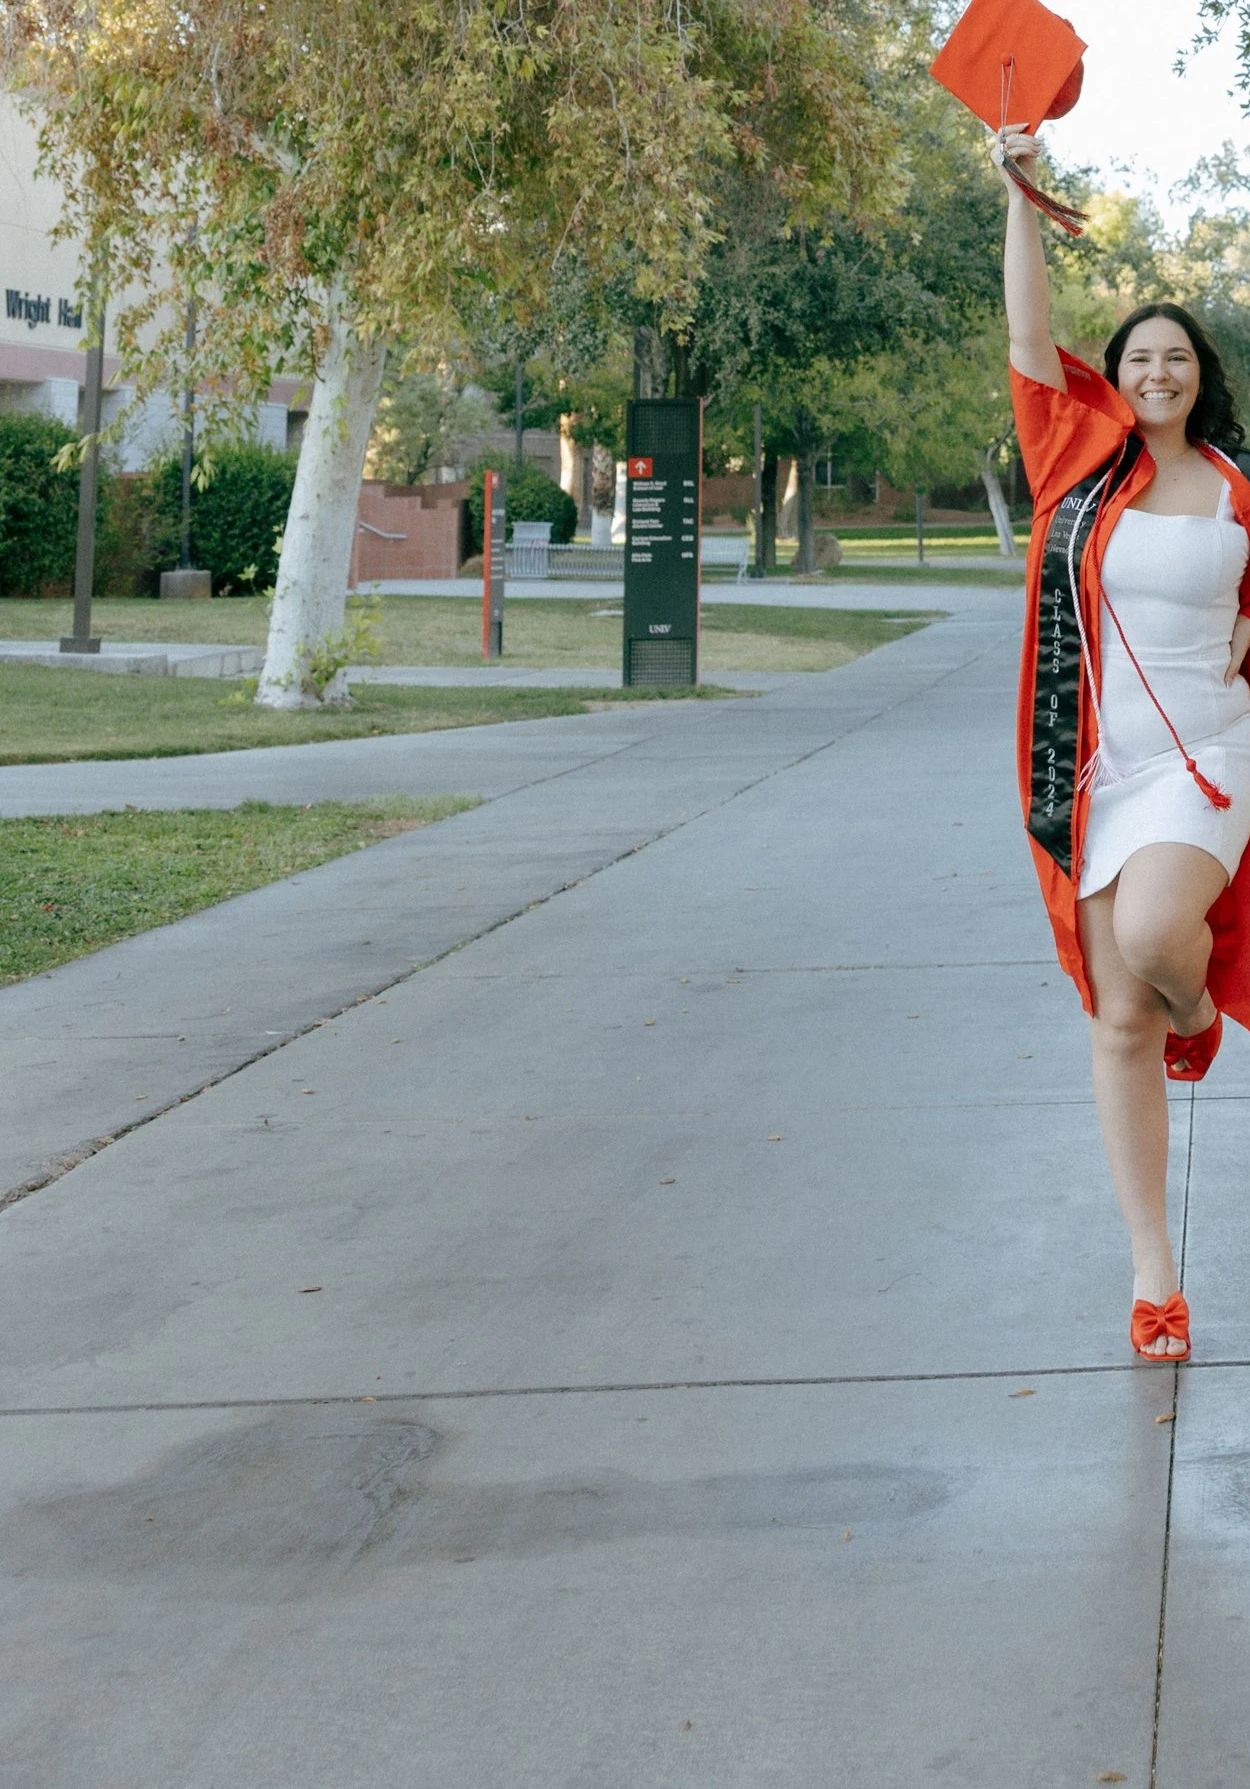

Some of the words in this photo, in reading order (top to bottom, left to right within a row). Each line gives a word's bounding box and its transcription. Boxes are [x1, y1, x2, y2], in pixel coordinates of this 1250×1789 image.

[6, 289, 50, 329] Wright
[1060, 496, 1097, 512] UNLV
[1054, 515, 1086, 529] Universy
[649, 624, 672, 635] UNLV
[1052, 588, 1062, 674] CLASS
[1048, 694, 1059, 727] OF
[1046, 748, 1057, 817] 2024
